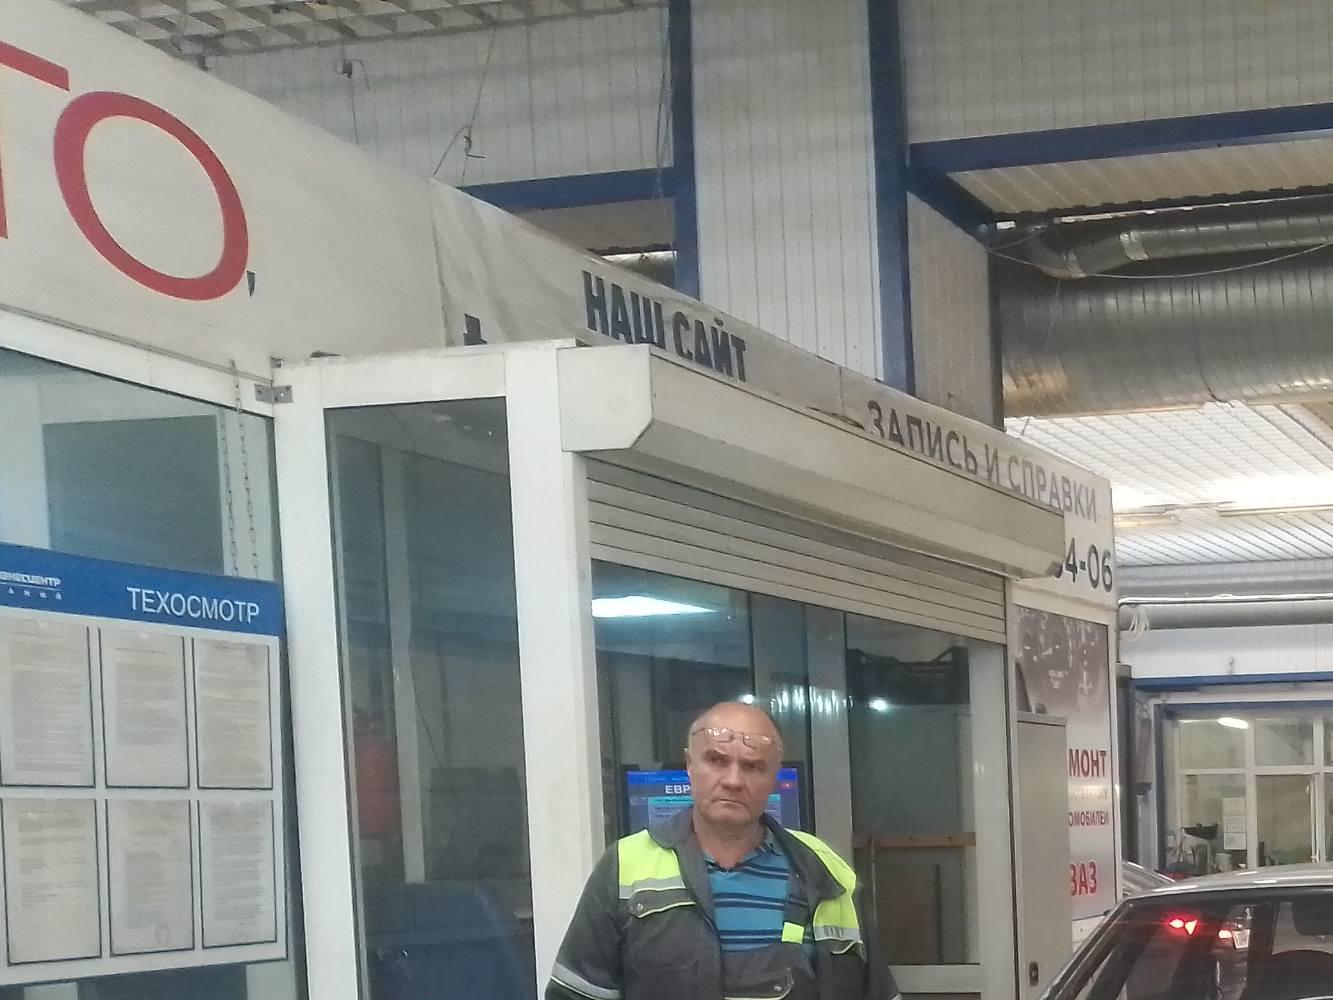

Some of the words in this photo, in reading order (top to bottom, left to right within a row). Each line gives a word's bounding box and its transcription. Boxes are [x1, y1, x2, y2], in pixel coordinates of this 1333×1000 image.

[582, 270, 667, 351] НАШ
[672, 311, 747, 383] САЙТ
[867, 400, 978, 474] ЗАПИСЬ
[984, 443, 1000, 488] И
[1008, 454, 1097, 523] СПРАВКИ
[126, 586, 260, 624] ТЕХОСМОТР
[1069, 748, 1107, 777] МОНТ
